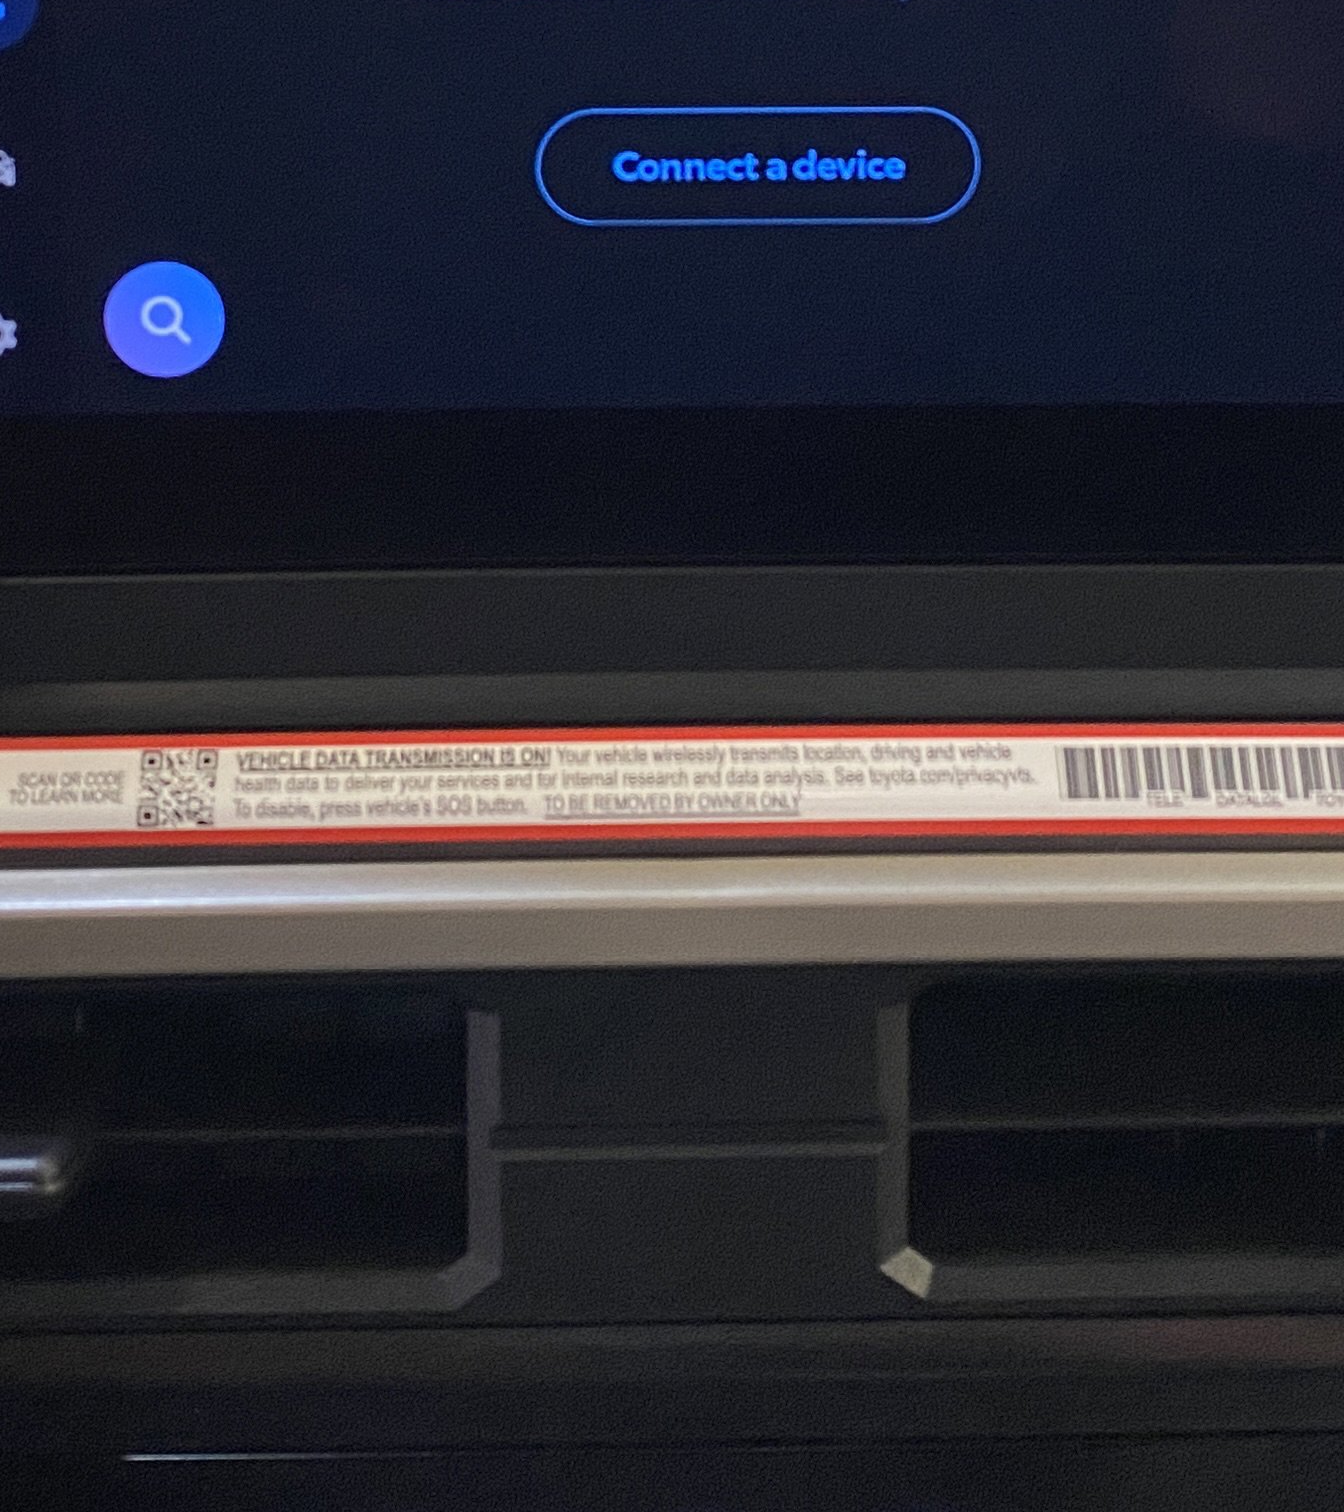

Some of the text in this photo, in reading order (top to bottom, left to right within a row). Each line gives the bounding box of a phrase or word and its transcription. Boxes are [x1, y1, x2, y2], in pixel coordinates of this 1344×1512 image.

[612, 148, 906, 182] Connect a device
[237, 742, 1012, 770] VEHICLE DATA TRANSMISSION IS ON! Your vehicle wirelessly transmits location, driving and vehicle
[17, 770, 58, 788] SCAN
[83, 769, 125, 787] CODE
[235, 774, 282, 792] health
[286, 774, 320, 792] data
[324, 774, 339, 792] to
[345, 774, 395, 791] deliver
[399, 774, 433, 794] your
[437, 772, 500, 790] services
[504, 772, 533, 789] and
[537, 771, 555, 788] for
[561, 769, 618, 788] internal
[622, 768, 688, 788] research
[693, 768, 721, 787] and
[725, 768, 758, 787] data
[763, 767, 830, 788] analysis.
[834, 766, 865, 785] See
[9, 787, 124, 805] TO LEARN MORE
[233, 789, 802, 822] To disable, press vehicle's SOS button. TO BE REMOVED BY OWNER ONLY
